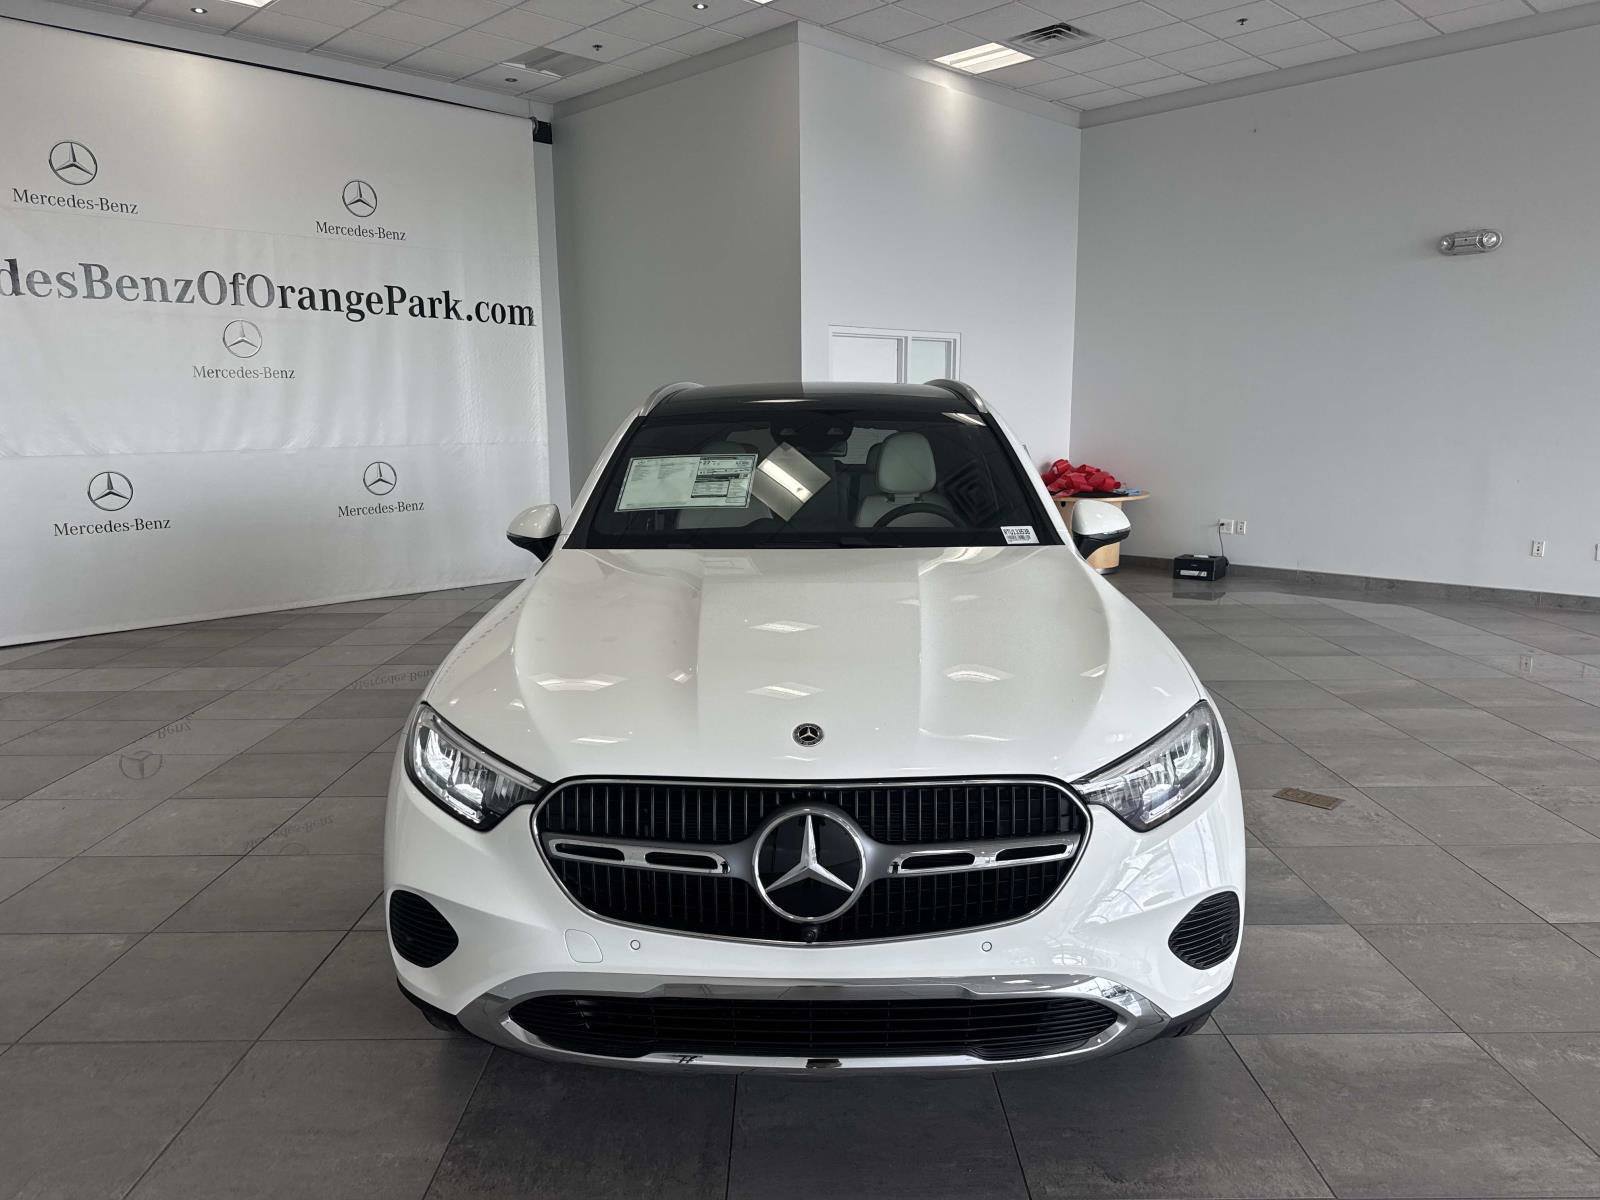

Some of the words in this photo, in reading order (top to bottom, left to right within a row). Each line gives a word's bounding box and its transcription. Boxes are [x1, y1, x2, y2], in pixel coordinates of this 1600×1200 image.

[12, 188, 138, 214] Mercedes-Benz
[316, 221, 406, 241] Mercedes-Benz
[192, 366, 295, 380] Mercedes-Benz
[338, 502, 424, 518] Mercedes-Benz
[53, 518, 170, 537] Mercedes-Benz
